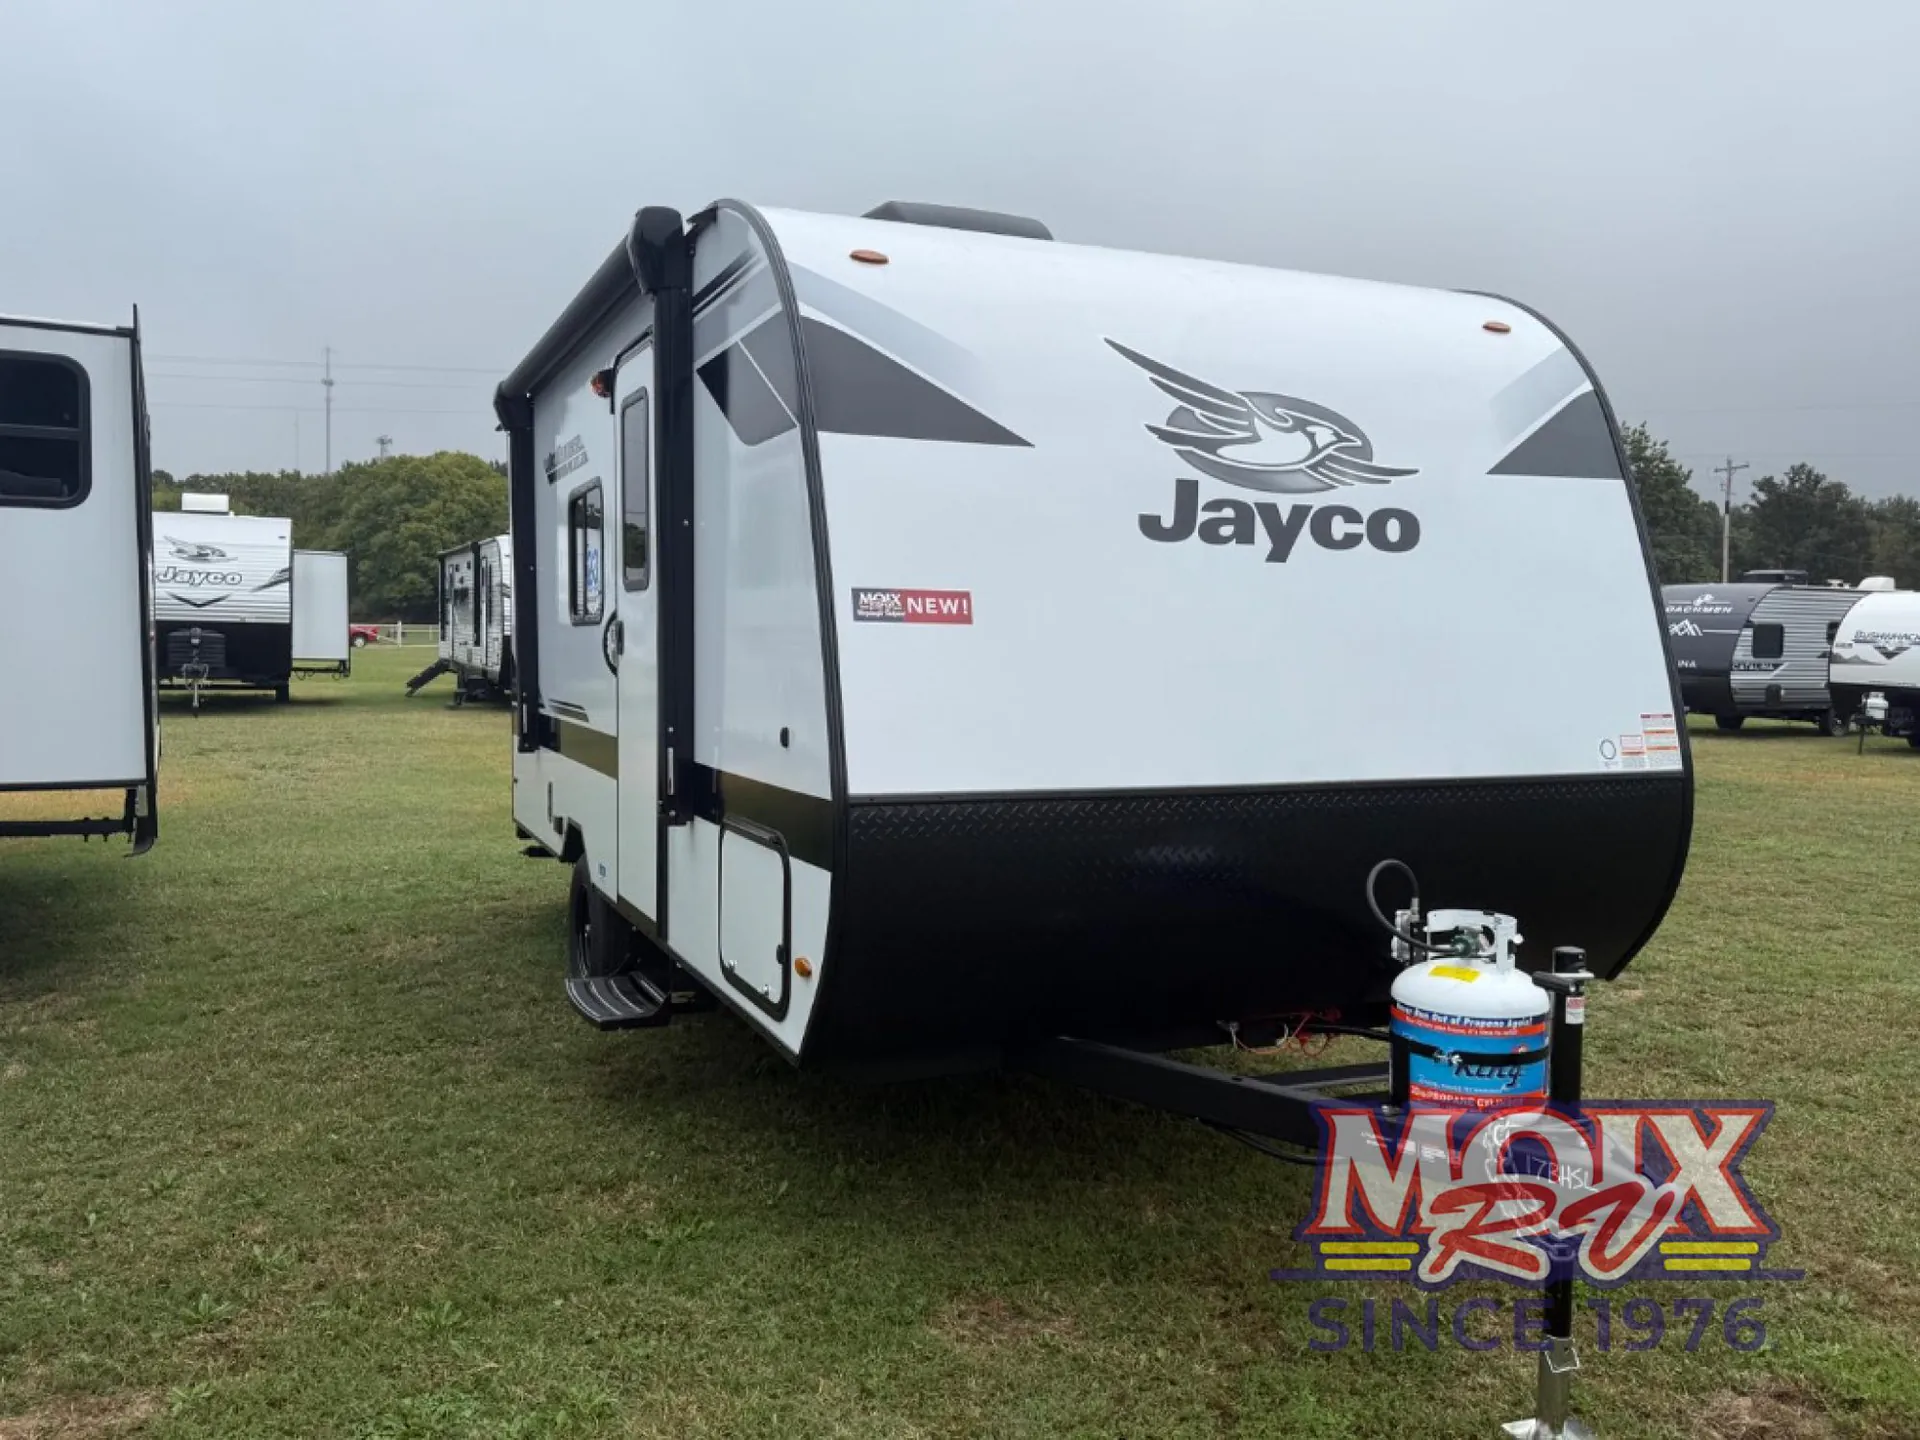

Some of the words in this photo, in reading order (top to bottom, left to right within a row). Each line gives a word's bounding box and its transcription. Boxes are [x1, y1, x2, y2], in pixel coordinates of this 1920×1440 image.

[1138, 478, 1420, 562] Jayco
[157, 566, 243, 587] Jayco
[907, 597, 969, 615] NEW!
[1665, 606, 1734, 614] OACHMEN
[1432, 1013, 1447, 1024] Out
[1450, 1016, 1461, 1025] of
[1464, 1017, 1505, 1028] Propane
